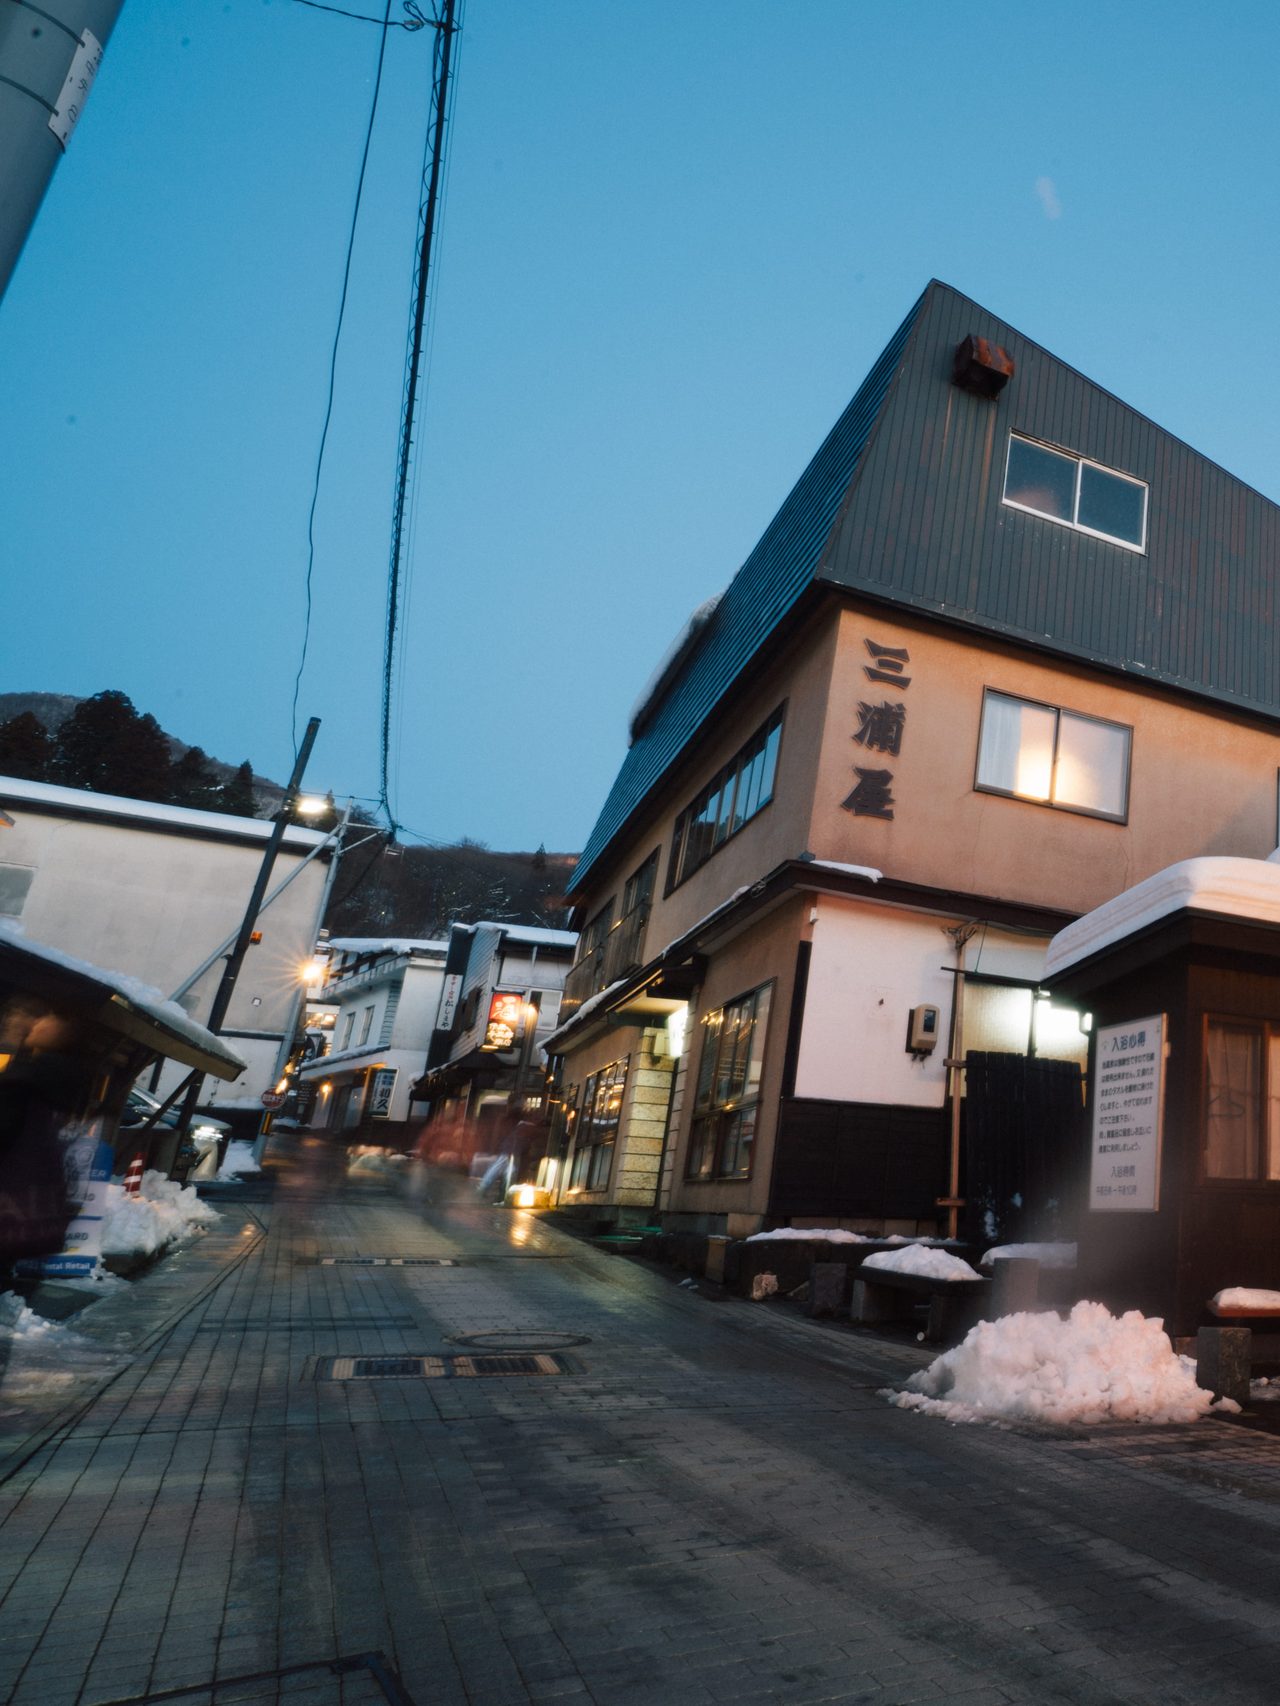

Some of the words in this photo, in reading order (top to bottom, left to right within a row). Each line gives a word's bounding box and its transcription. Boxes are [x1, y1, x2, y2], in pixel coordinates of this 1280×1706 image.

[841, 637, 911, 821] 三浦屋
[1111, 1030, 1146, 1052] 入浴心得
[65, 1261, 90, 1270] Retail
